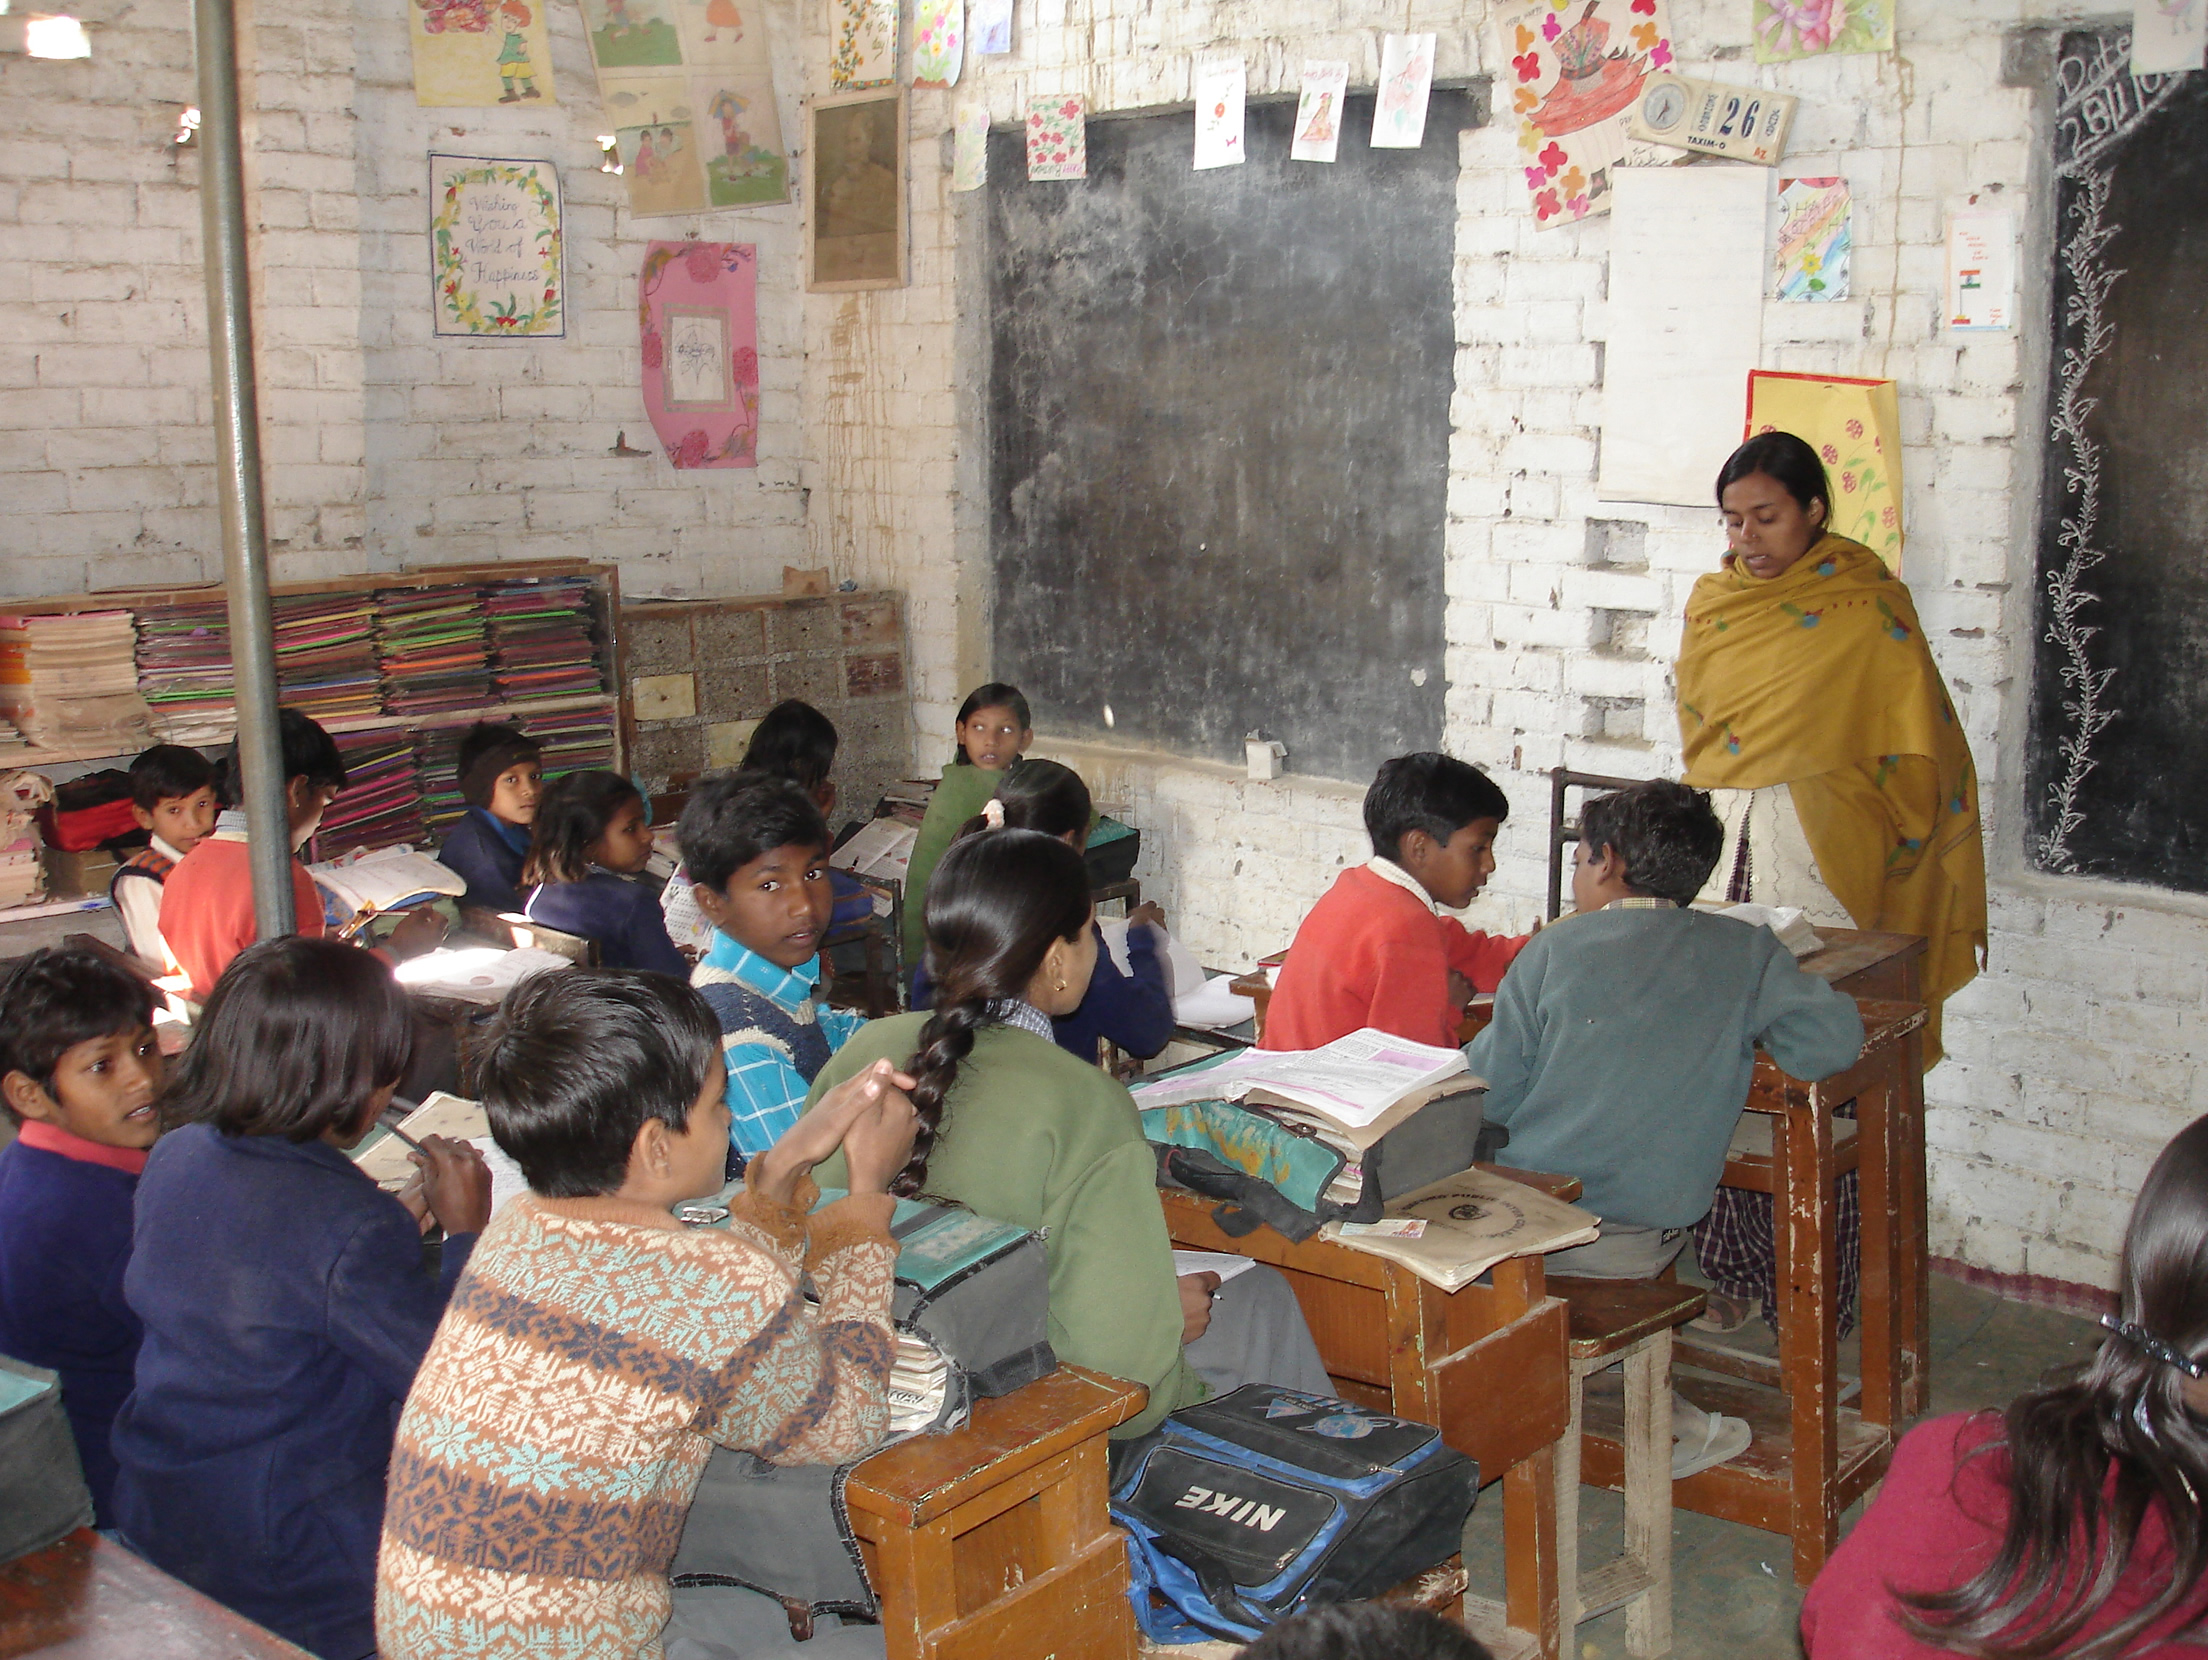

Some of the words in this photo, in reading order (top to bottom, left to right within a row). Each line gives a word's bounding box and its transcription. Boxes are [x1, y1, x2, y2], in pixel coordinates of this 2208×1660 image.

[2057, 35, 2132, 98] Date
[1718, 97, 1760, 138] 26
[1687, 135, 1726, 150] TAXIM-O
[505, 236, 524, 259] of
[1174, 1485, 1287, 1533] NIKE
